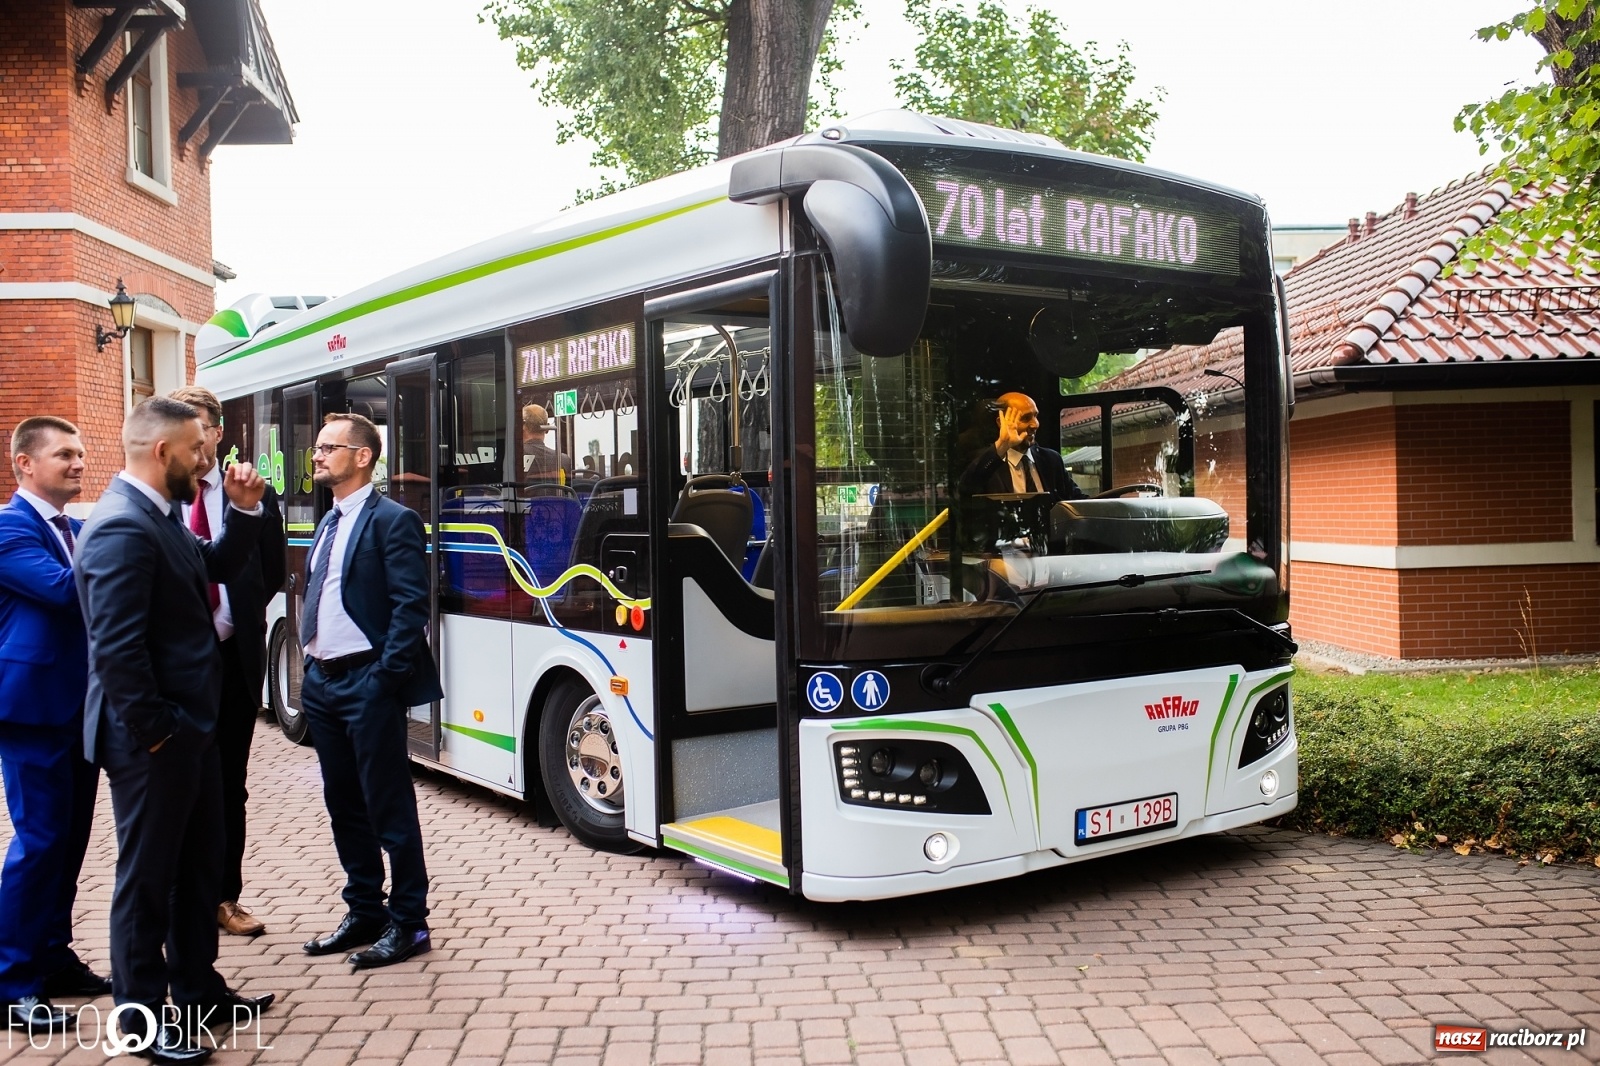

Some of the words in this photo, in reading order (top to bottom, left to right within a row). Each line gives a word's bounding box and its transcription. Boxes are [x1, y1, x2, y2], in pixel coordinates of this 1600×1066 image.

[935, 181, 985, 240] 70
[995, 188, 1045, 247] lat
[1065, 199, 1198, 264] RAFAKO
[521, 348, 539, 383] 70
[541, 343, 561, 379] lat
[567, 327, 631, 375] RAFAKO
[1144, 695, 1200, 720] RAFAKO
[1158, 725, 1176, 733] GRUPA
[1178, 722, 1189, 731] PBG
[1078, 828, 1086, 836] PL
[1090, 808, 1112, 835] S1
[1133, 798, 1173, 827] 139B
